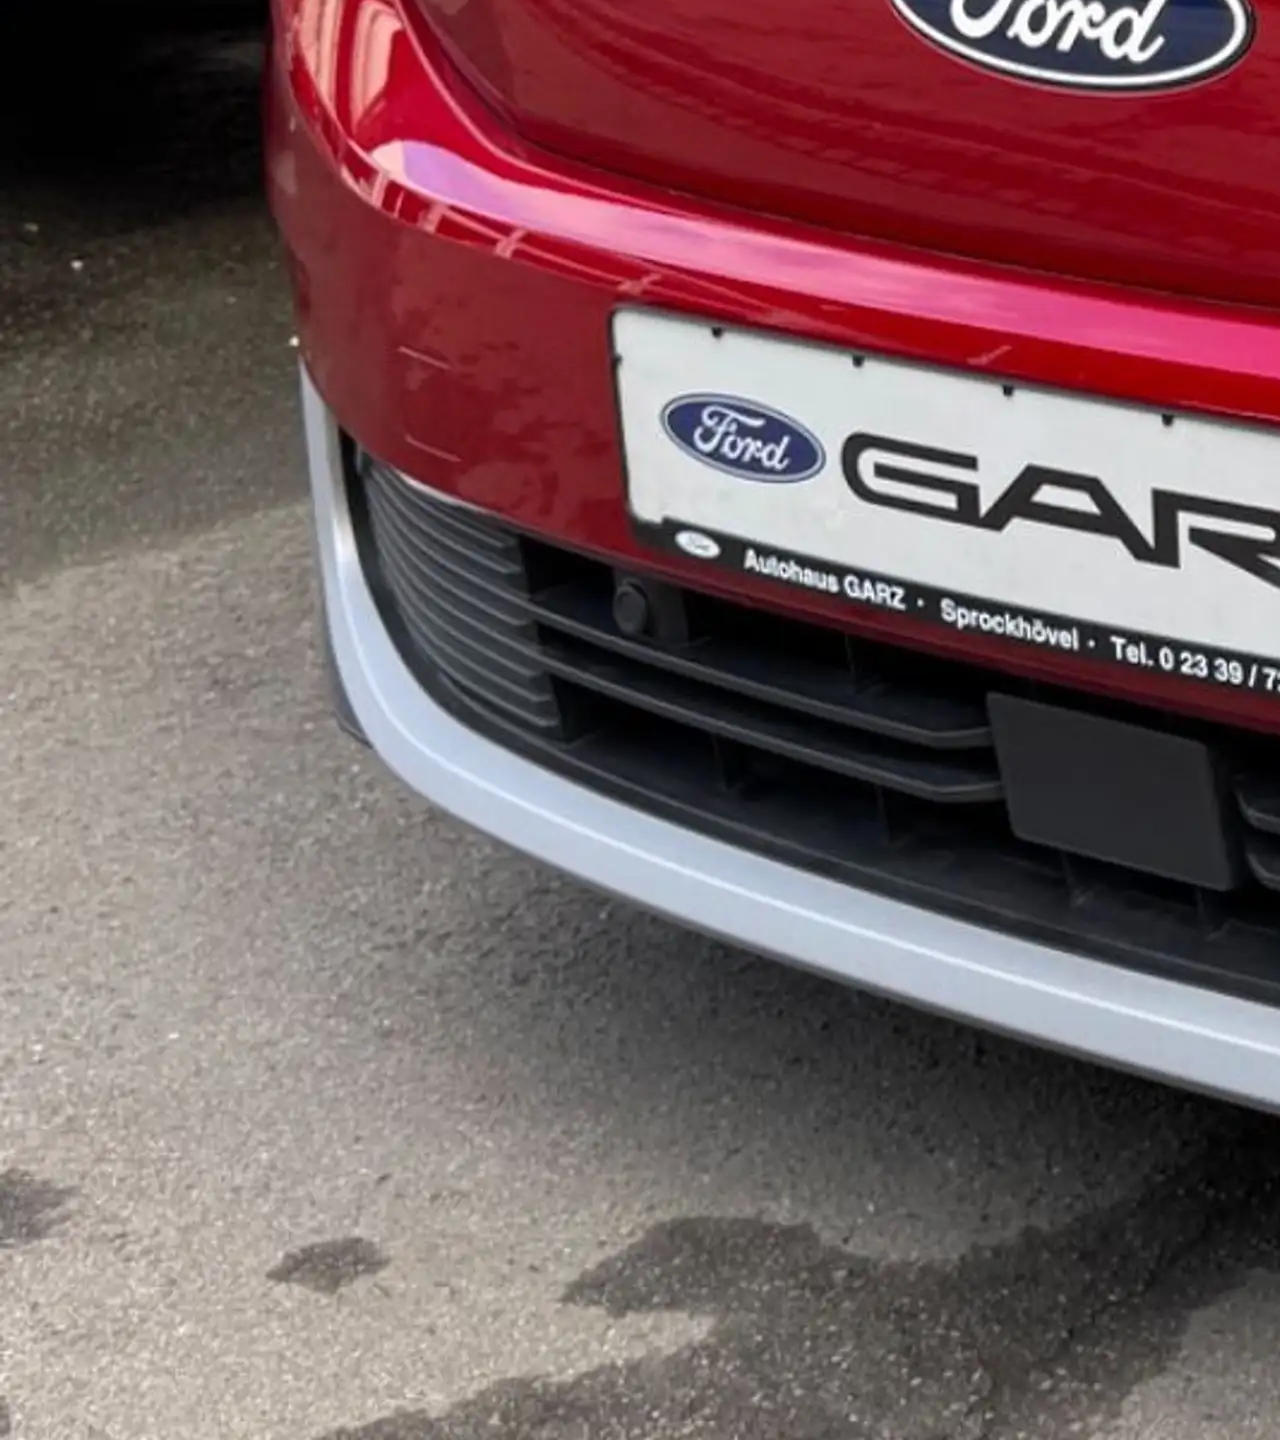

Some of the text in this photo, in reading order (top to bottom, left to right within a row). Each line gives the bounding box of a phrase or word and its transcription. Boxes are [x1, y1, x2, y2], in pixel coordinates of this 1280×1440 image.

[693, 404, 790, 471] Ford
[743, 547, 840, 594] Autohaus
[843, 574, 906, 610] GARZ
[940, 597, 1080, 651] Sprockhövel
[1109, 634, 1154, 667] Tel.
[1158, 646, 1174, 670] 0
[1179, 654, 1209, 678] 23
[1213, 658, 1245, 686] 39
